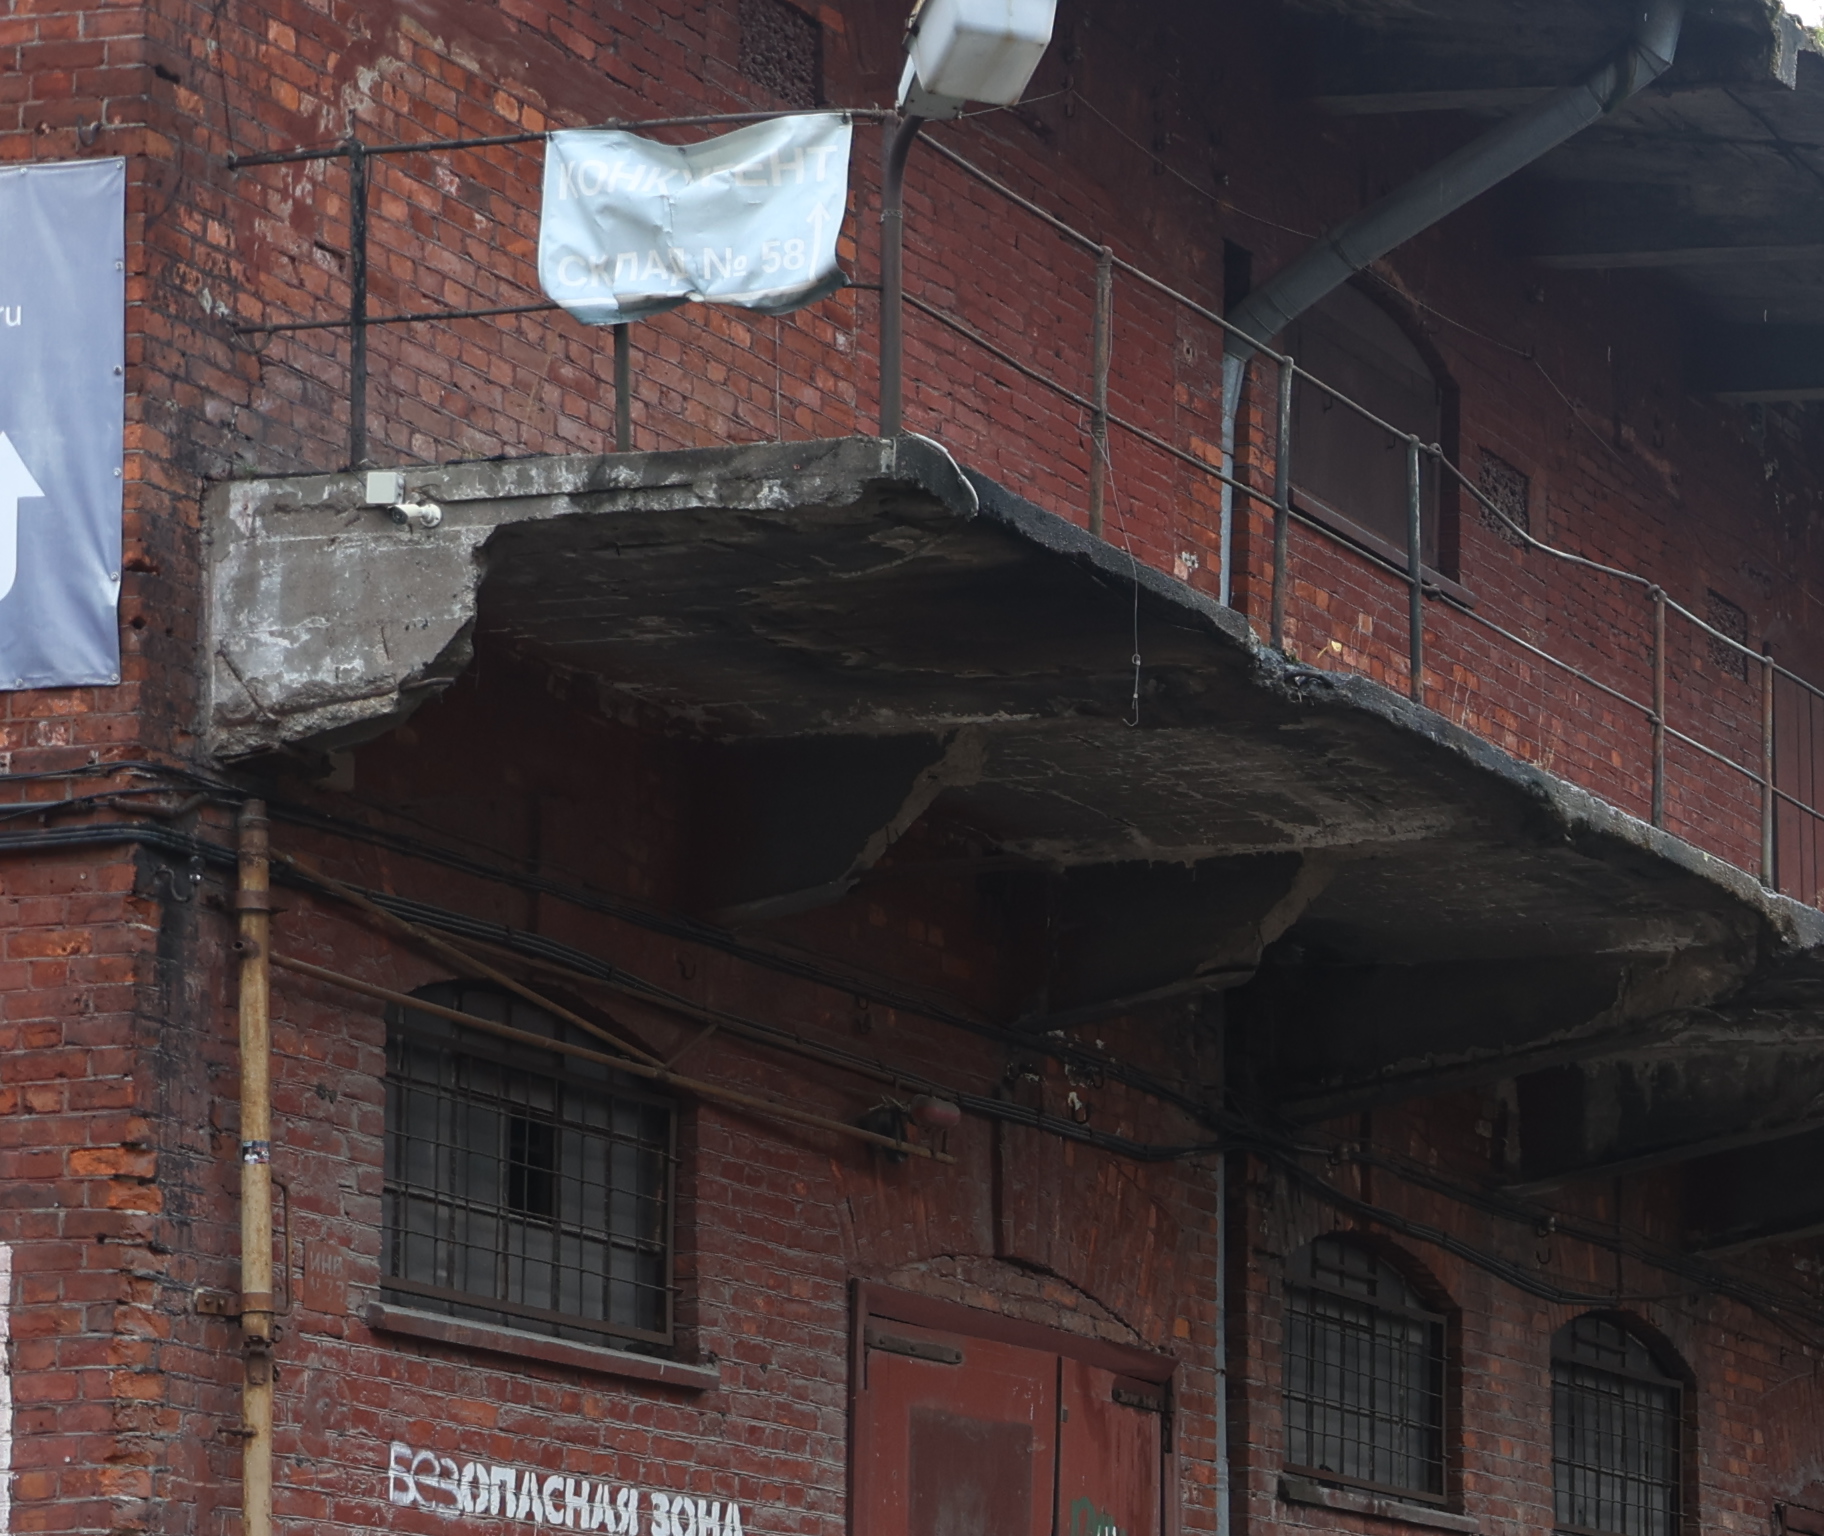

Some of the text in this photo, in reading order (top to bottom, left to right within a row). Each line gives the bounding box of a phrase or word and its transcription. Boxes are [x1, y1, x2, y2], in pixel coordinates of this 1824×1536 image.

[558, 238, 806, 288] СКЛАД № 58
